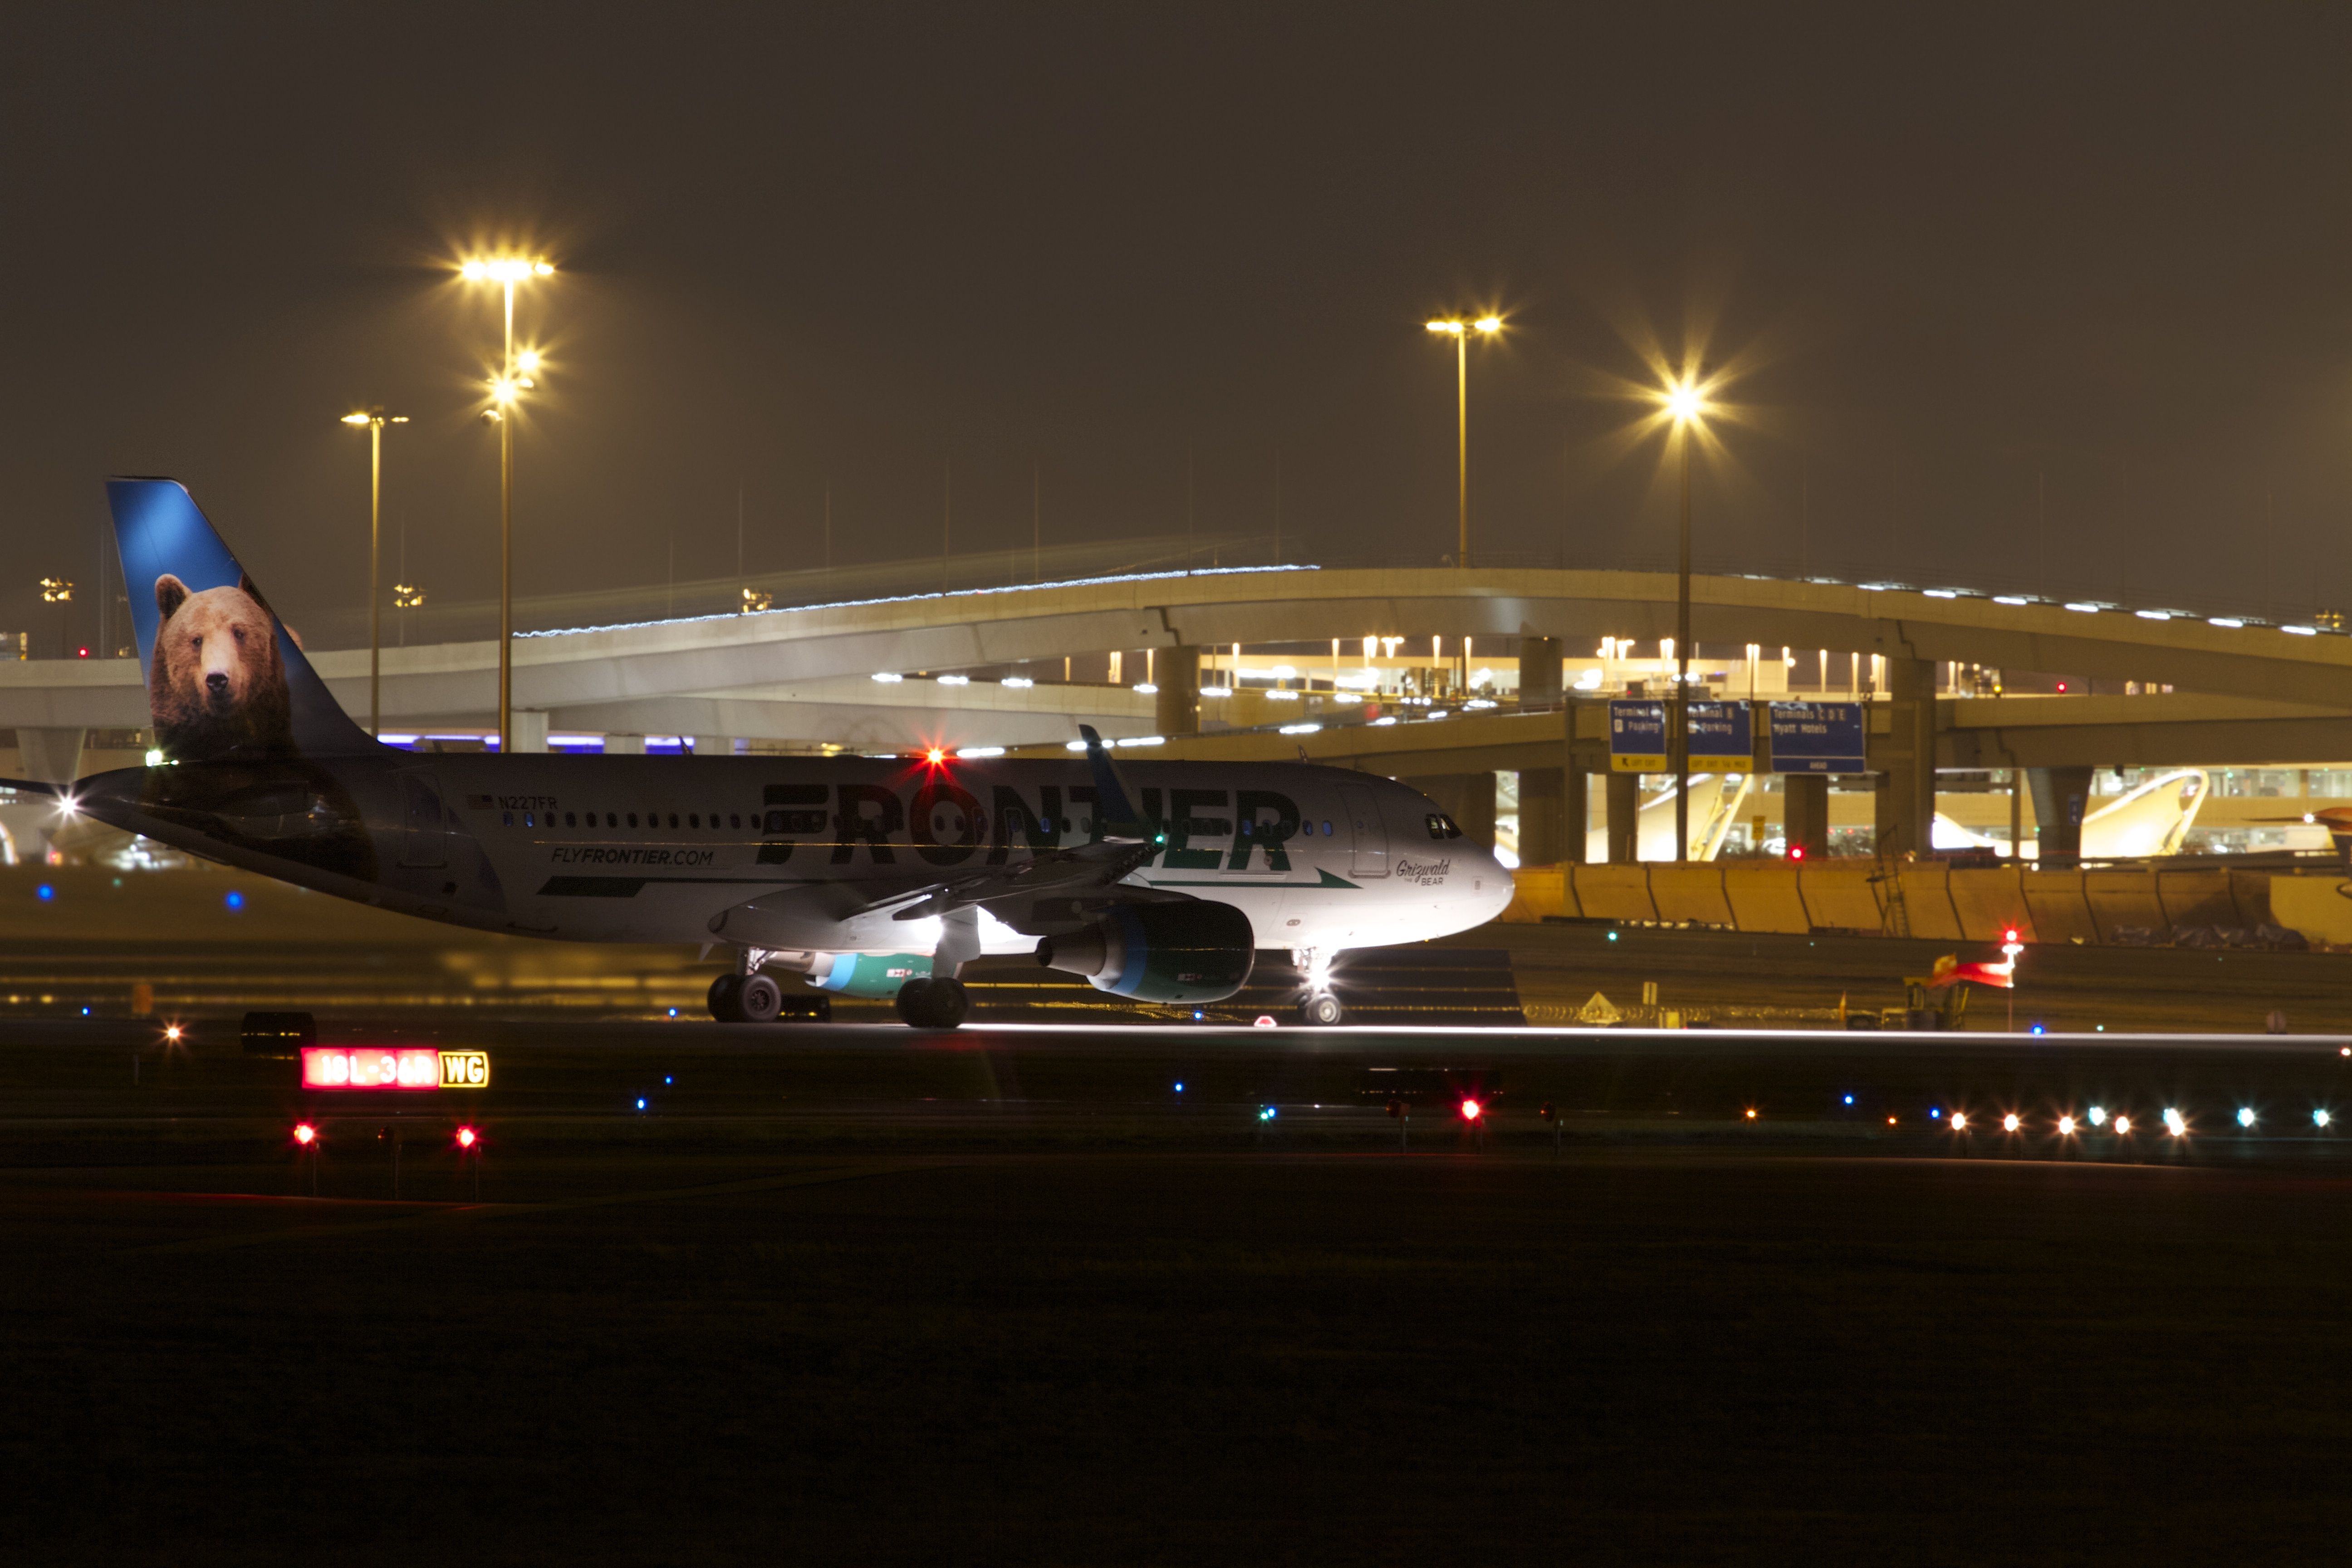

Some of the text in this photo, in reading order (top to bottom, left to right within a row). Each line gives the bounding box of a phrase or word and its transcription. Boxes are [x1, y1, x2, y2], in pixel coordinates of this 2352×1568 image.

[1614, 707, 1649, 717] Terminal
[1774, 709, 1814, 719] Terminals
[1818, 708, 1824, 720] C
[1838, 709, 1846, 721] E
[1628, 721, 1659, 733] Parking
[1701, 722, 1732, 735] Parking
[1774, 724, 1827, 735] Hyatt Hotels
[499, 796, 558, 810] N227FR
[551, 848, 714, 865] FLYFRONTIER.COM
[1396, 859, 1450, 883] Grizwald
[1421, 877, 1444, 886] BEAR
[321, 1055, 485, 1083] 18L-36R WG
